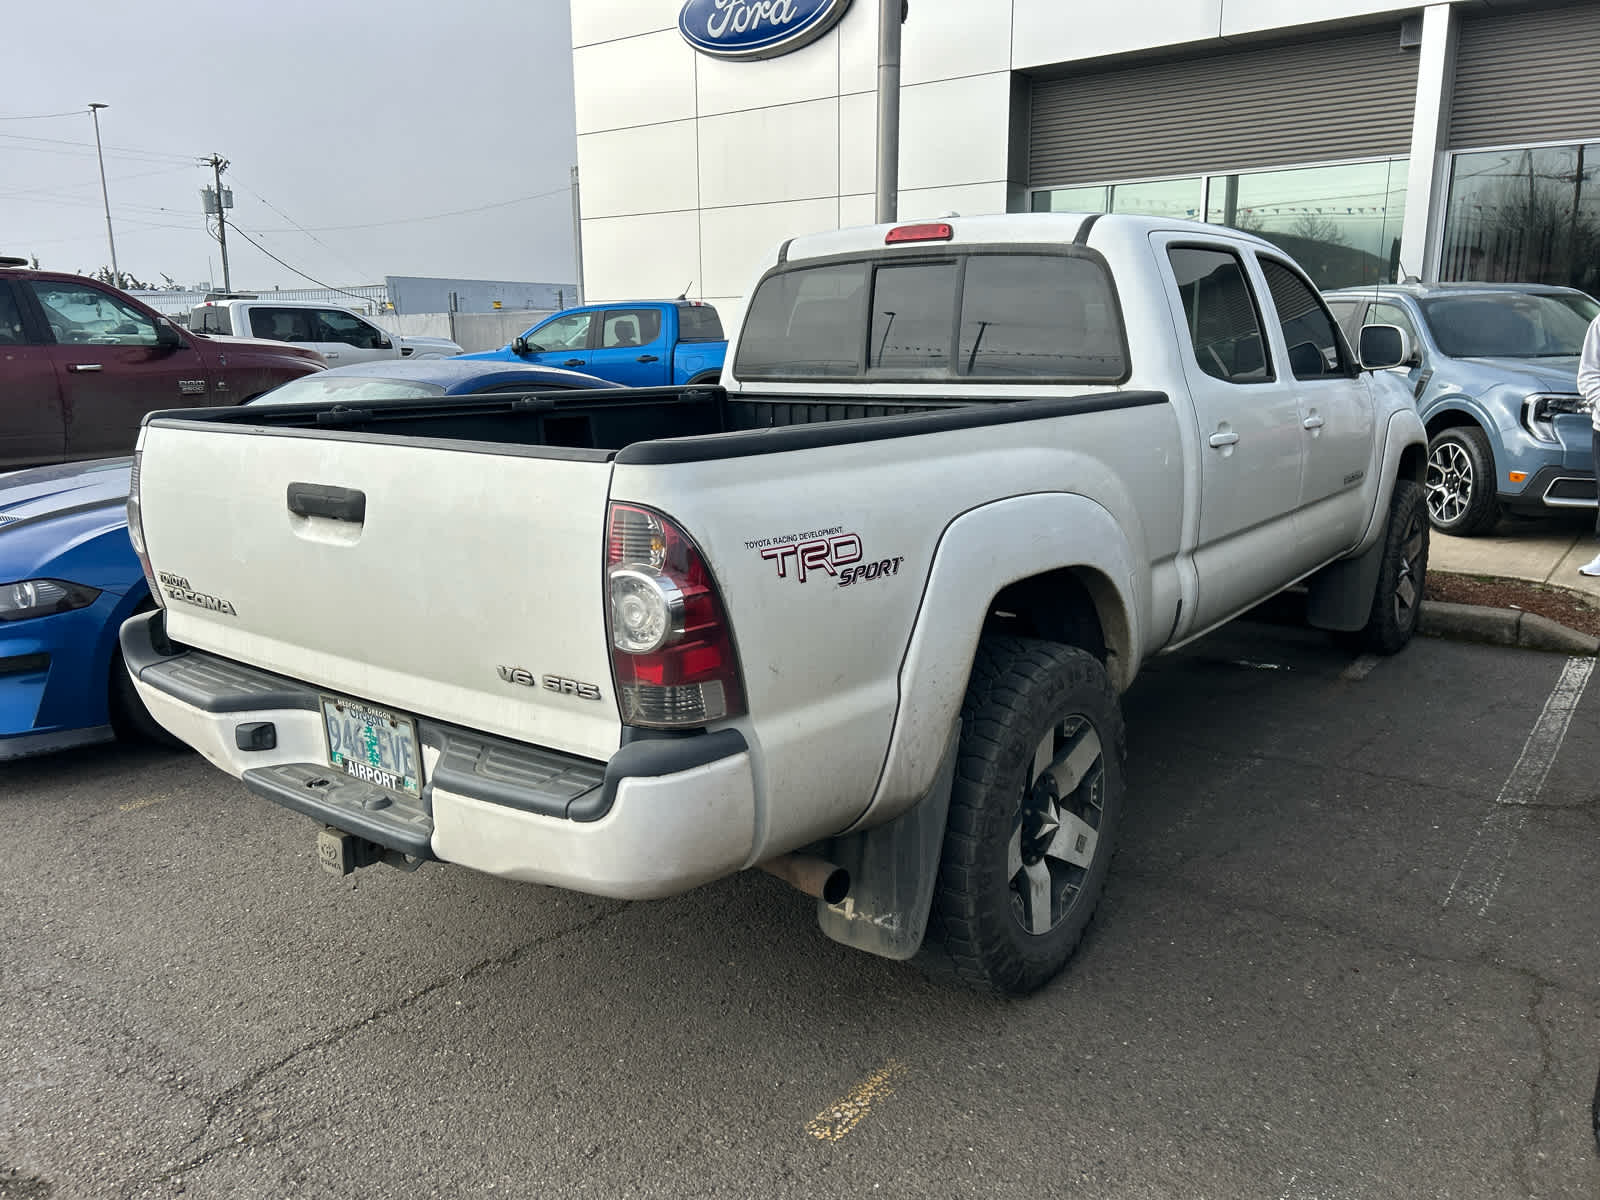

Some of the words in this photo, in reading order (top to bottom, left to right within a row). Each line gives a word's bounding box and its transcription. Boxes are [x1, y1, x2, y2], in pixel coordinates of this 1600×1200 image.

[707, 0, 798, 38] Ford
[745, 539, 771, 549] TOYOTA
[773, 534, 798, 545] RACING
[799, 526, 843, 541] DEVELOPMENT
[760, 533, 863, 583] TRD
[838, 556, 905, 588] SPORT
[164, 584, 238, 617] TACOMA
[496, 664, 535, 687] V6
[541, 674, 602, 701] SR5
[367, 707, 392, 720] OREGON
[348, 760, 397, 791] AIRPORT
